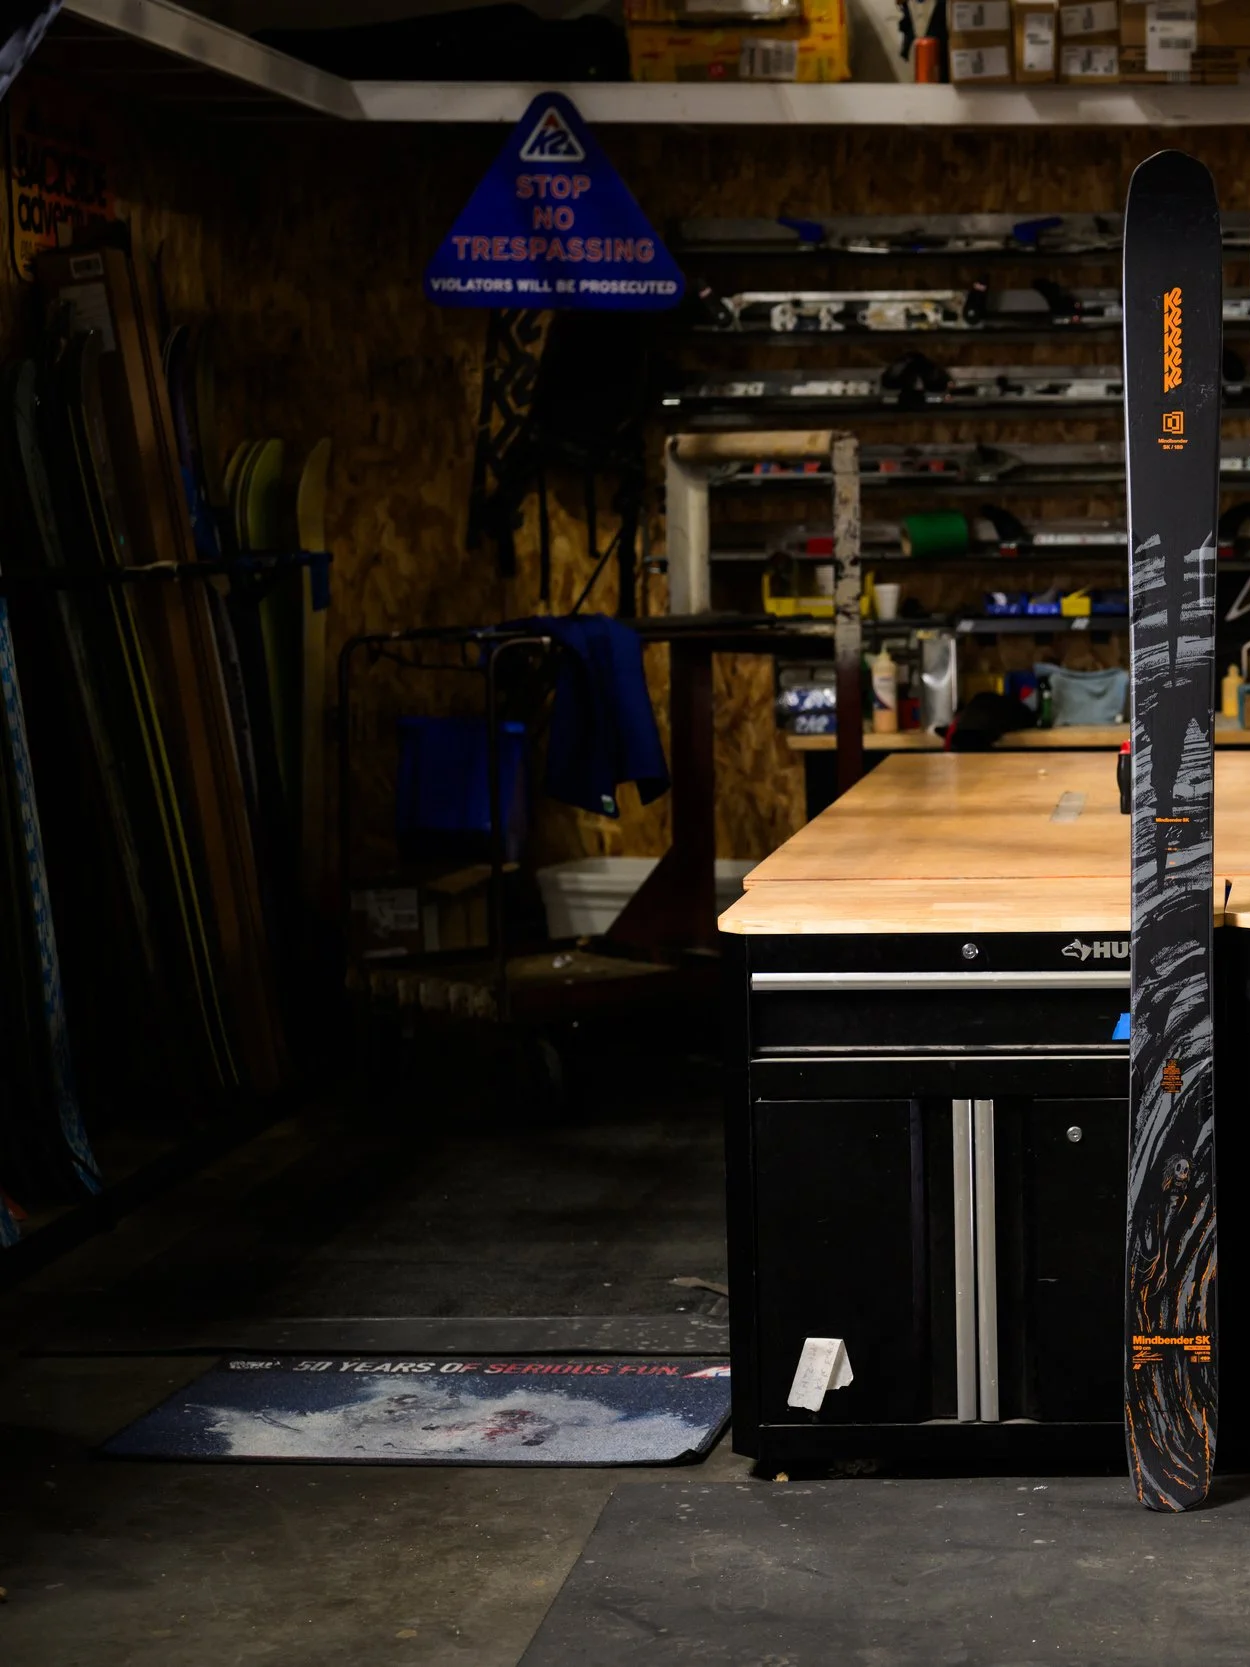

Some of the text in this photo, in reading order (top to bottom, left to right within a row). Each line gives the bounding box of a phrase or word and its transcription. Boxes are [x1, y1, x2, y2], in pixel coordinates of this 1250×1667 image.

[515, 173, 592, 200] STOP
[531, 204, 575, 231] NO
[451, 235, 655, 264] TRESPASSING
[430, 277, 678, 296] VIOLATORS WILL BE PROSECUTED
[1093, 941, 1131, 958] HU
[1132, 1335, 1210, 1345] Mindbender SK
[292, 1361, 333, 1372] 50
[338, 1361, 436, 1373] YEARS
[439, 1362, 481, 1374] OF
[483, 1362, 613, 1375] SERIOUS
